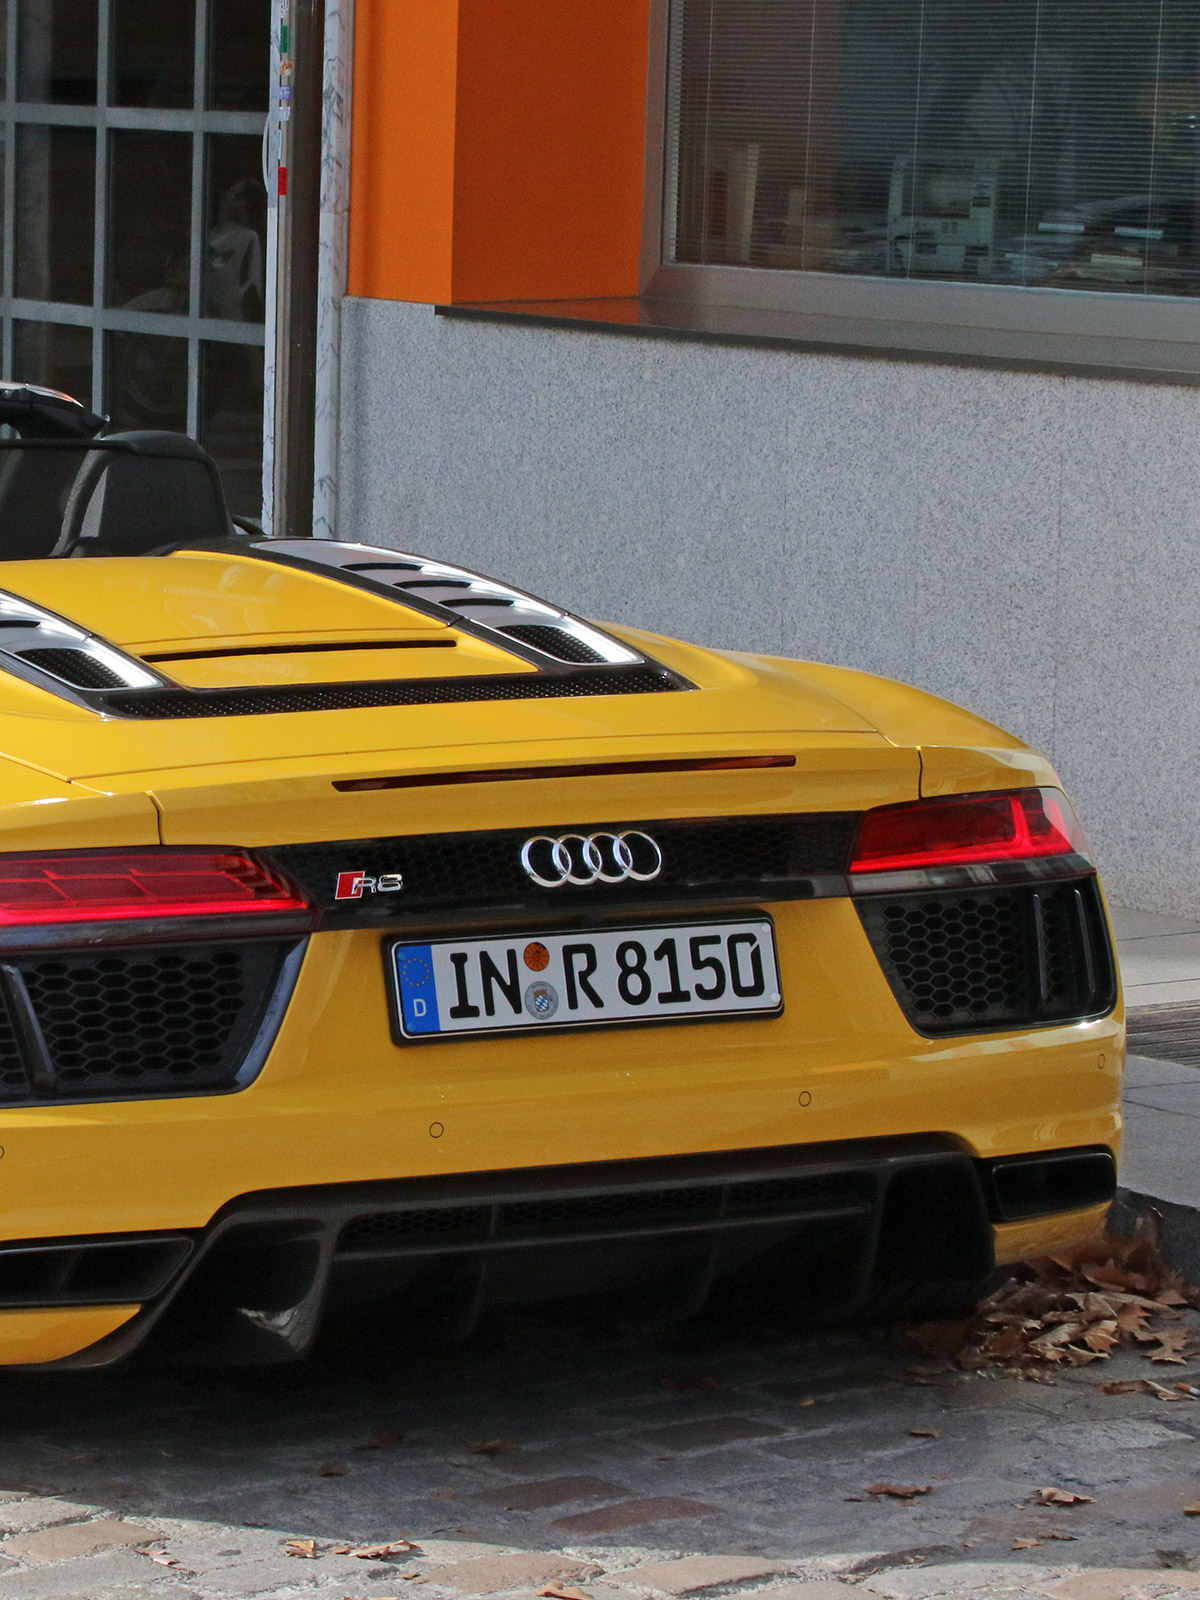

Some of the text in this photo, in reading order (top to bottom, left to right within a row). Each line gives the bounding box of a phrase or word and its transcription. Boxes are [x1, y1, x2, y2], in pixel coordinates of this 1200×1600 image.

[350, 873, 404, 896] R8
[449, 948, 523, 1020] IN
[562, 943, 605, 1010] R
[615, 932, 765, 1006] 8150
[413, 998, 427, 1018] D
